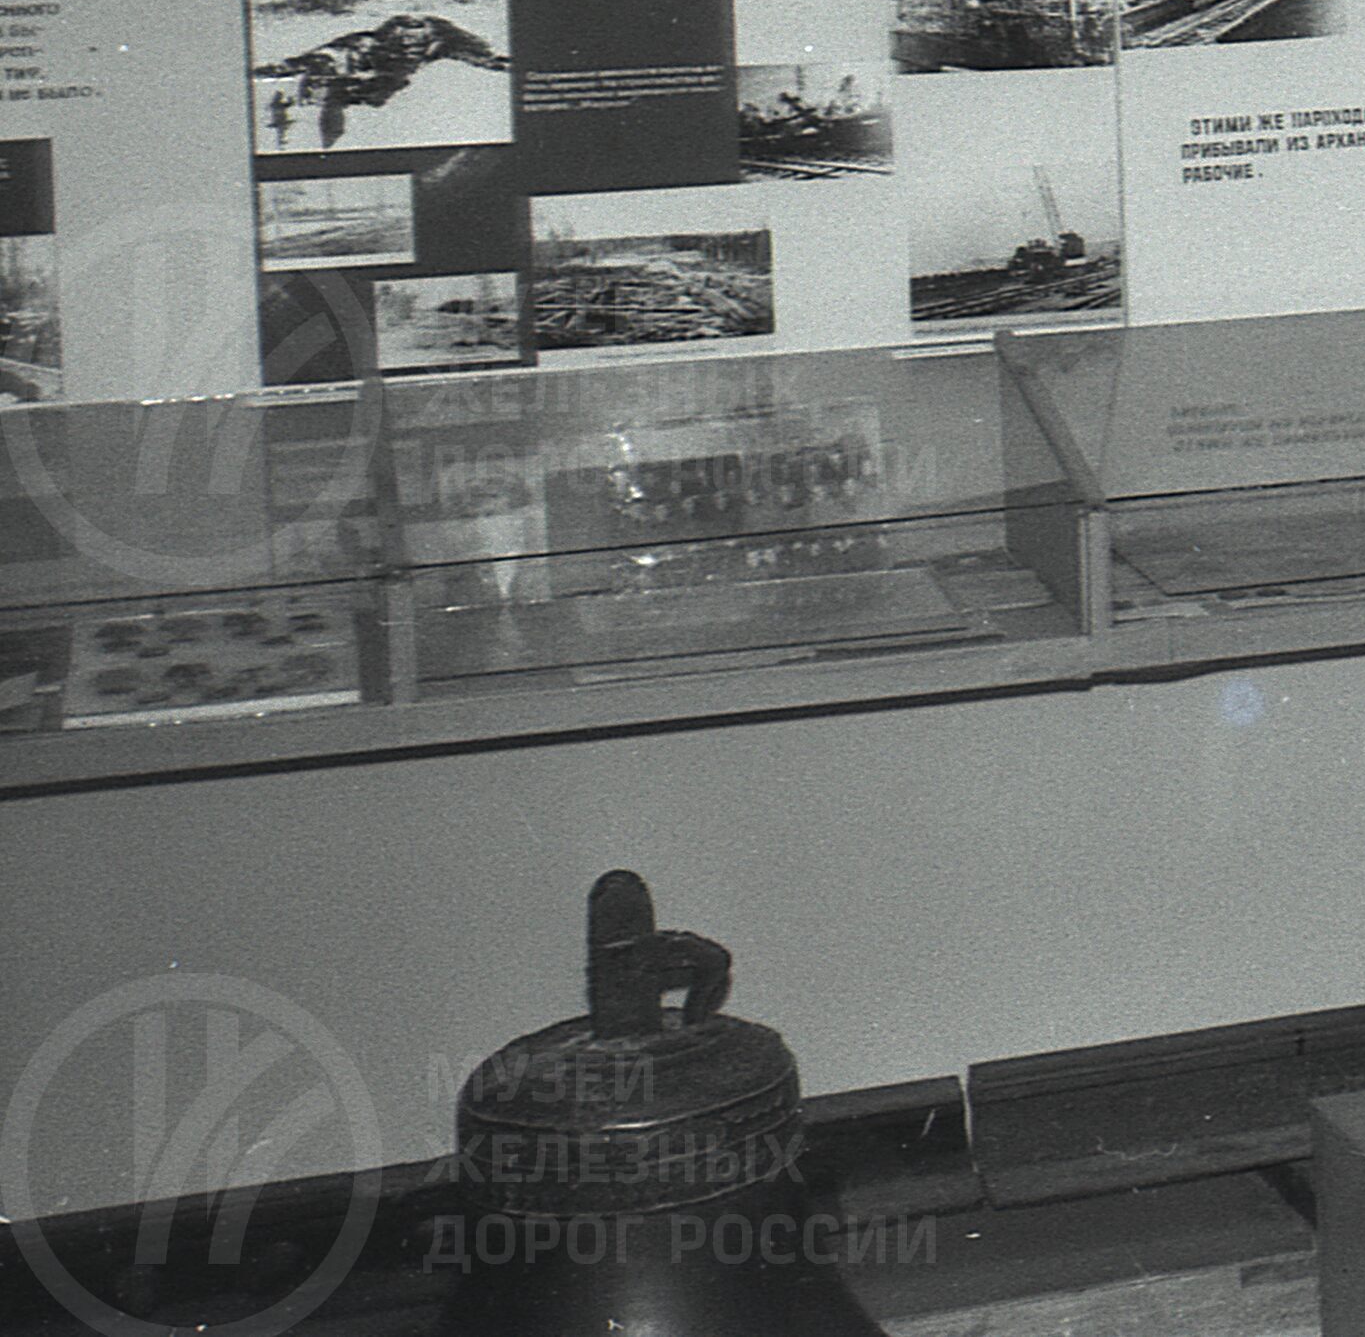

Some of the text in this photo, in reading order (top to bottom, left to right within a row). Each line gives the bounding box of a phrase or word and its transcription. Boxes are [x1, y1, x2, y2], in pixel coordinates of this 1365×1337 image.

[1190, 115, 1252, 135] ЭТИМИ
[1257, 113, 1285, 130] ЖЕ
[1181, 137, 1279, 159] ПРИБЫВАЛИ
[1286, 135, 1309, 152] ИЗ
